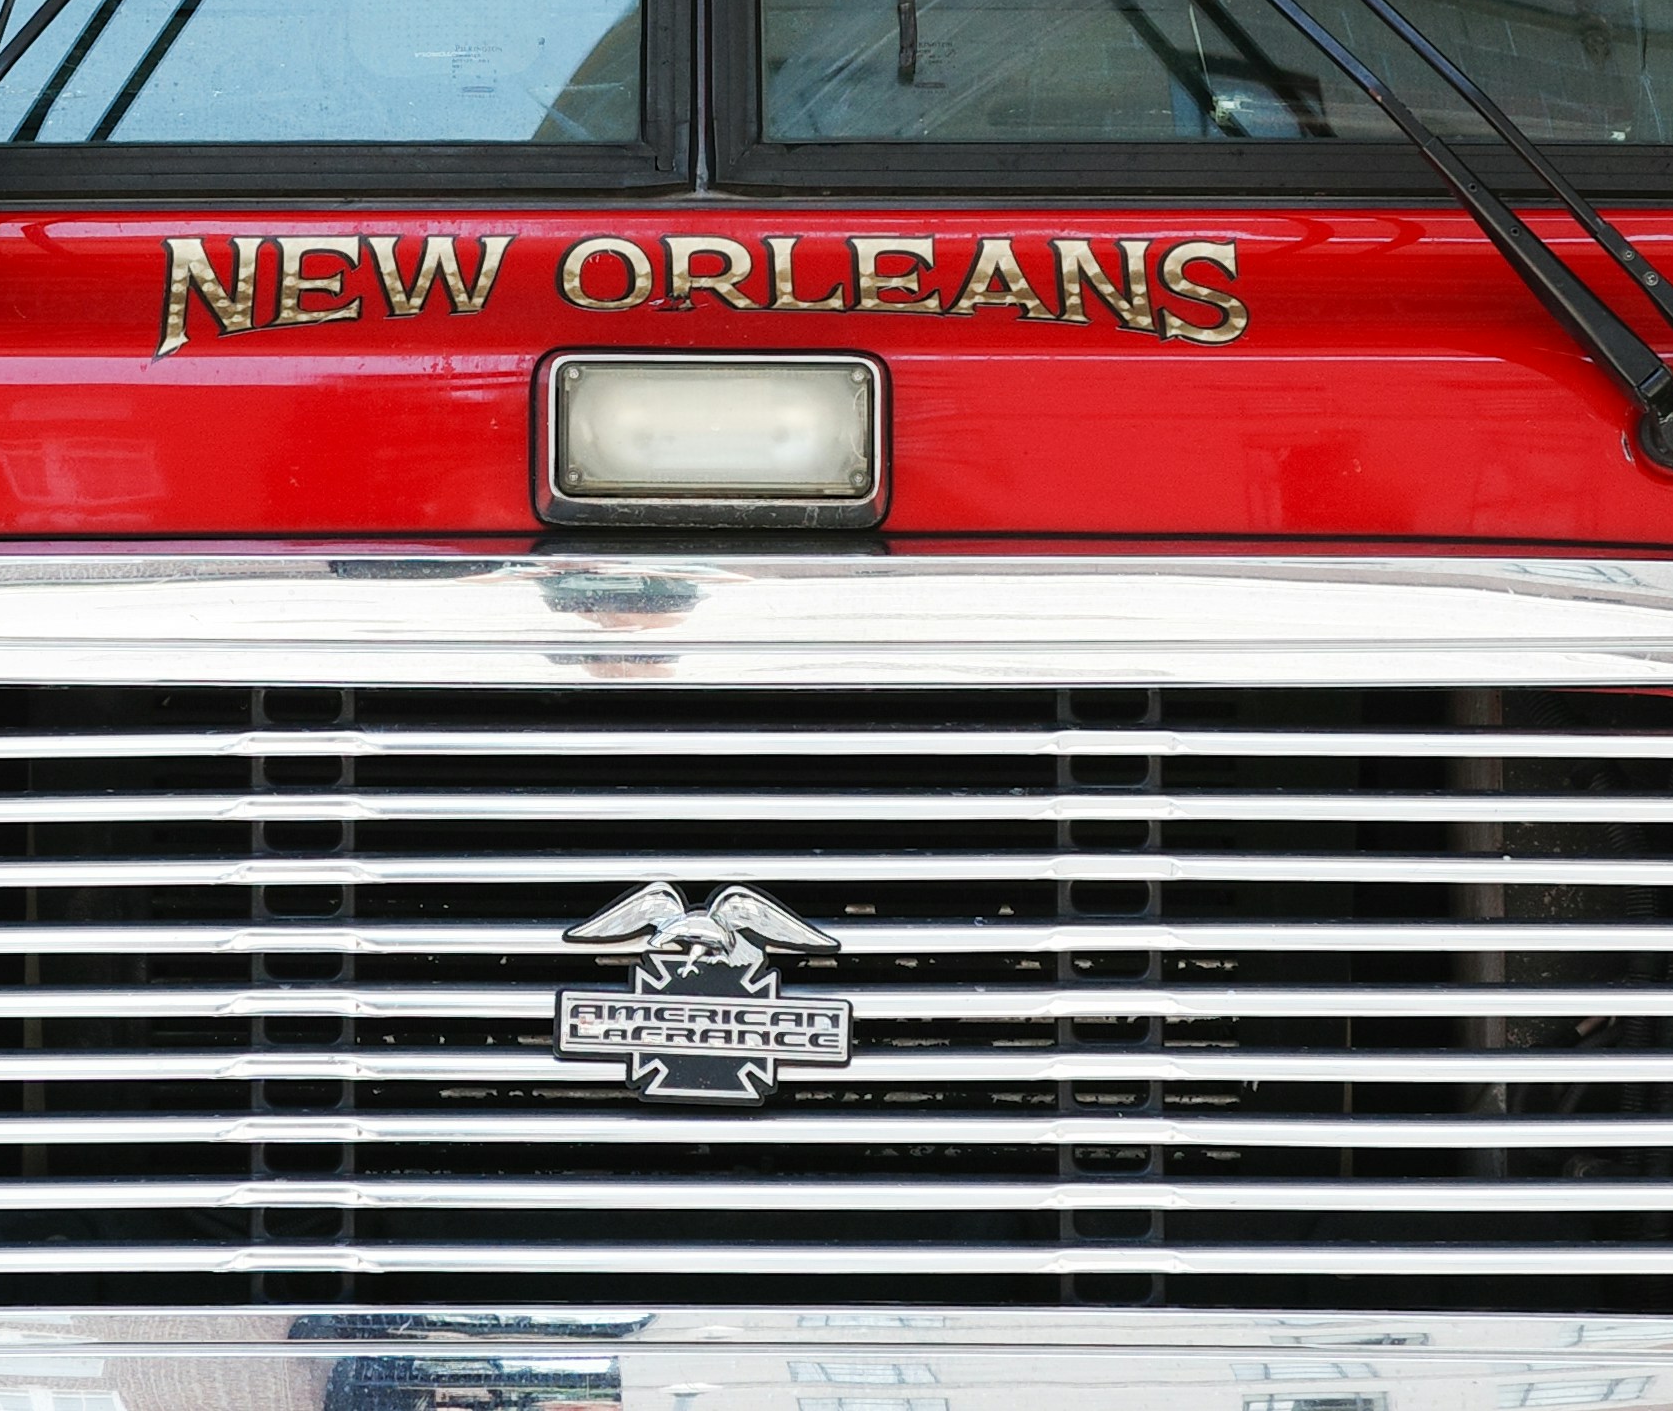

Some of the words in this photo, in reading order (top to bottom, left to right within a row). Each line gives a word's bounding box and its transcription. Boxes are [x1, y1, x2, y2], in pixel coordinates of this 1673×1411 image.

[151, 234, 517, 364] NEW
[556, 233, 1252, 347] ORLEANS
[570, 1004, 840, 1029] AMERICAN
